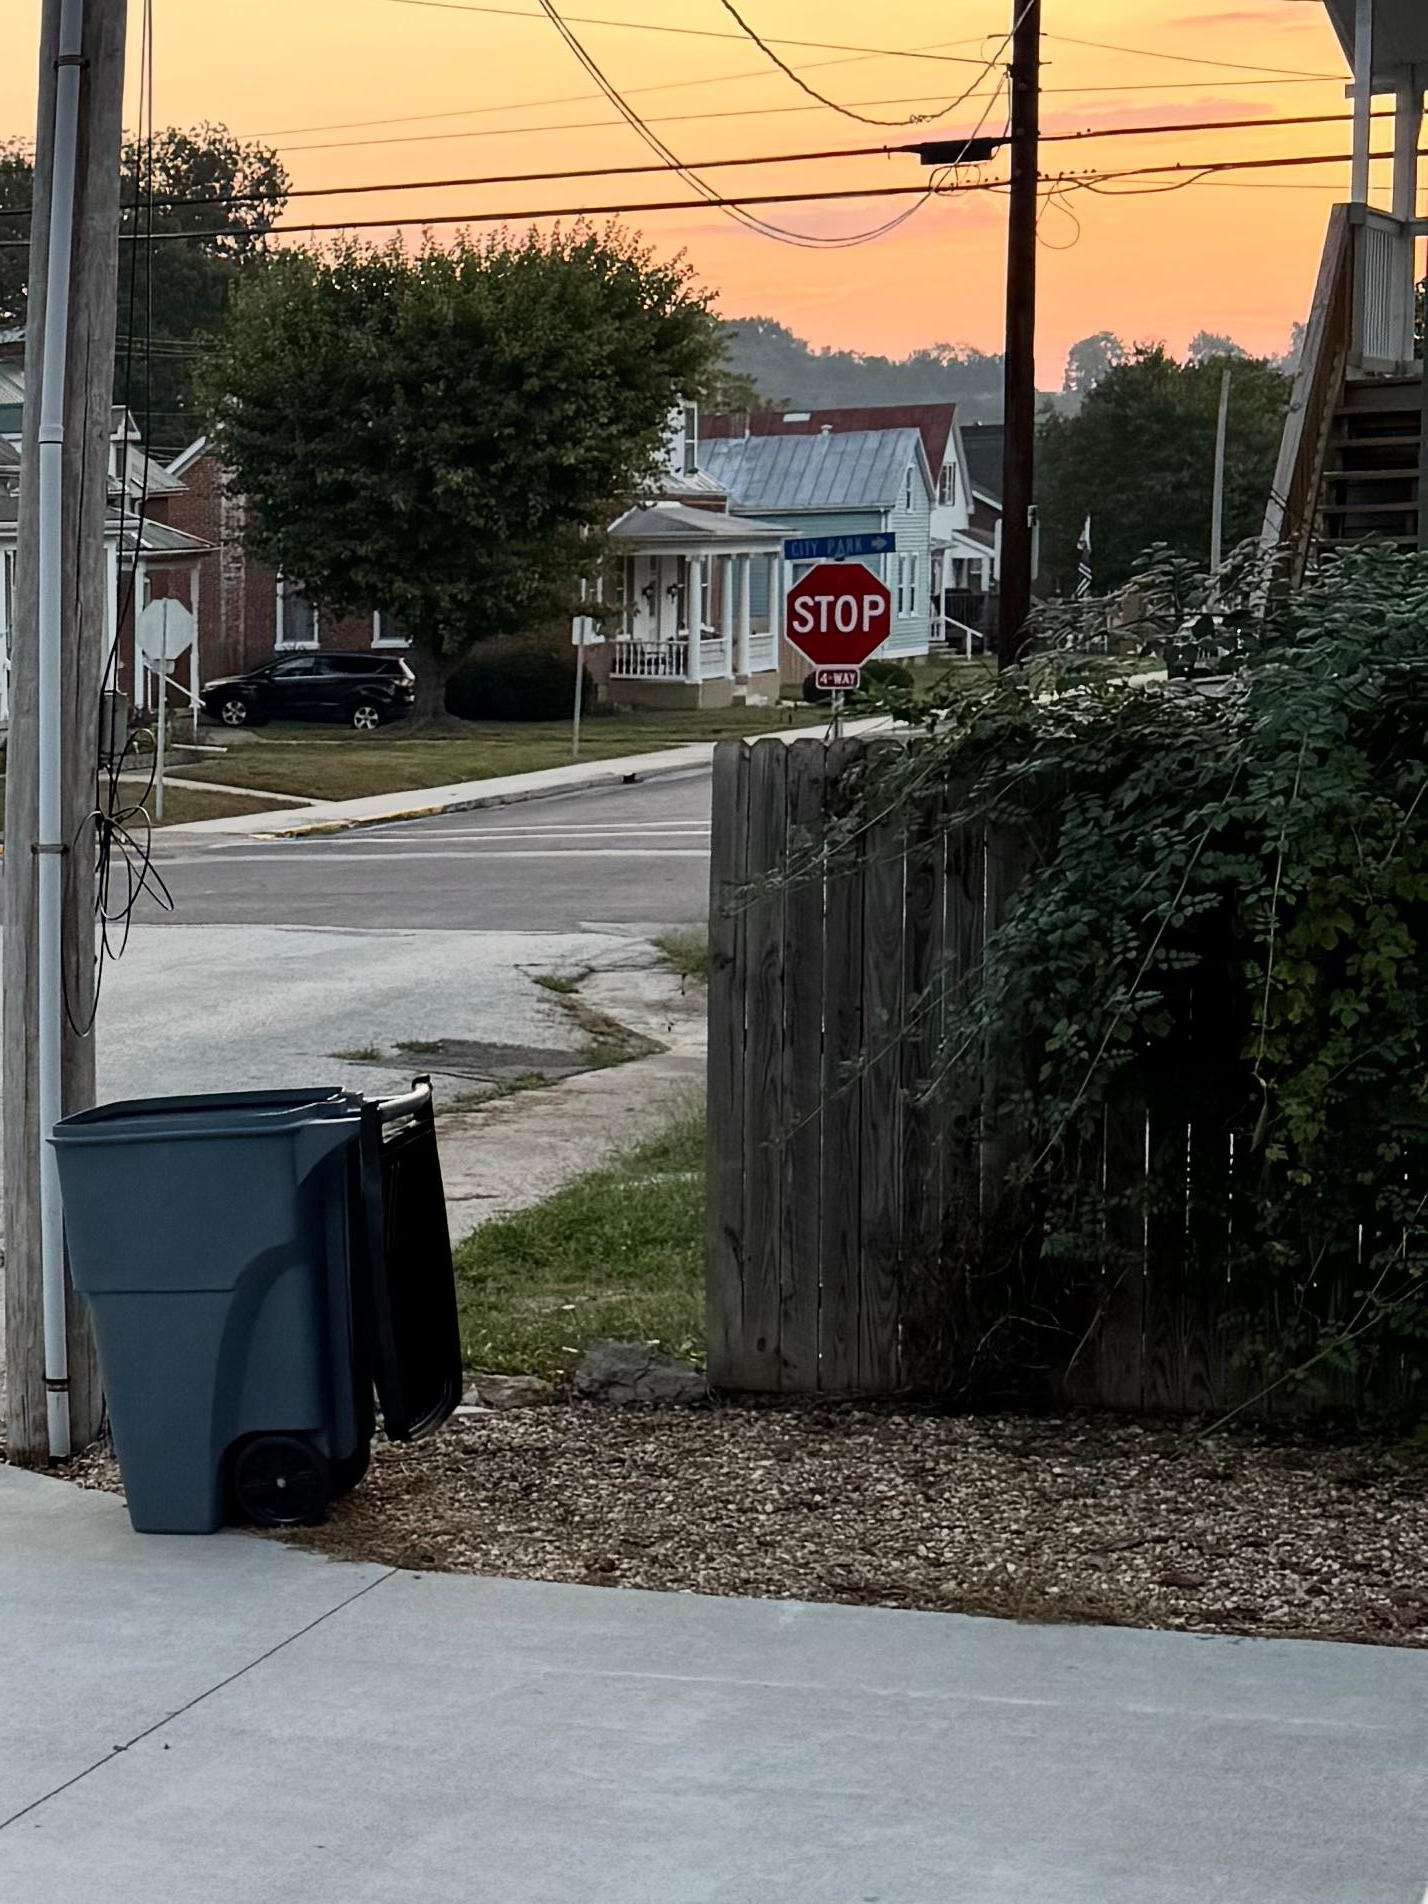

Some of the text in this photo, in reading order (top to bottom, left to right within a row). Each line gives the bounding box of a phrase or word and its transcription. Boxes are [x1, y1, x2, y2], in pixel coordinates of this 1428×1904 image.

[790, 536, 864, 557] CITY PARK
[792, 595, 885, 633] STOP
[819, 672, 856, 685] 4-WAY
